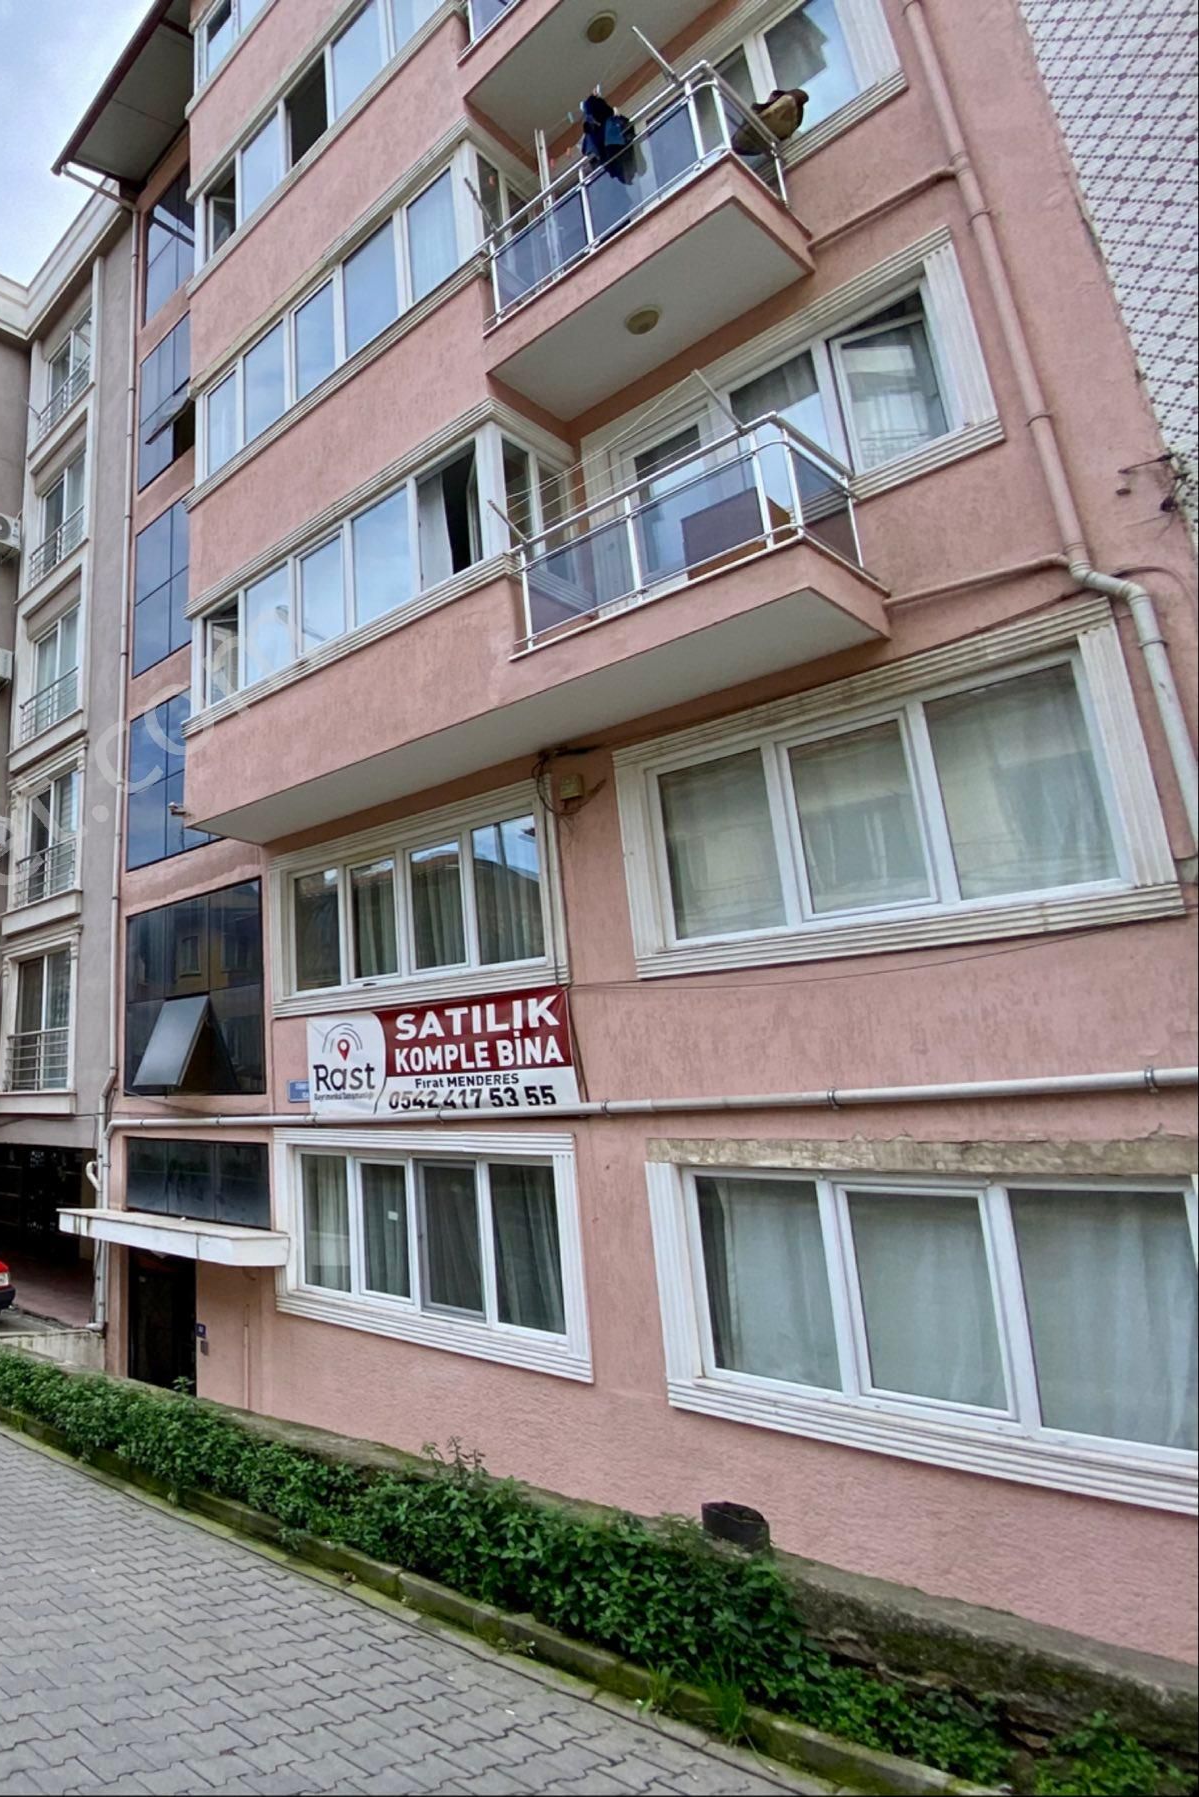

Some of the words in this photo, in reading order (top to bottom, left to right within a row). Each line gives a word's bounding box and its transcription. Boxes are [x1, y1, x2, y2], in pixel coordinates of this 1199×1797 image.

[395, 995, 560, 1041] SATILIK
[395, 1041, 491, 1073] KOMPLE
[496, 1031, 564, 1067] BİNA
[313, 1063, 375, 1091] Rast
[415, 1077, 443, 1089] Fırat
[447, 1073, 519, 1088] MENDERES
[389, 1091, 438, 1110] 0542
[443, 1088, 482, 1109] 417
[489, 1086, 519, 1107] 53
[524, 1085, 556, 1105] 55
